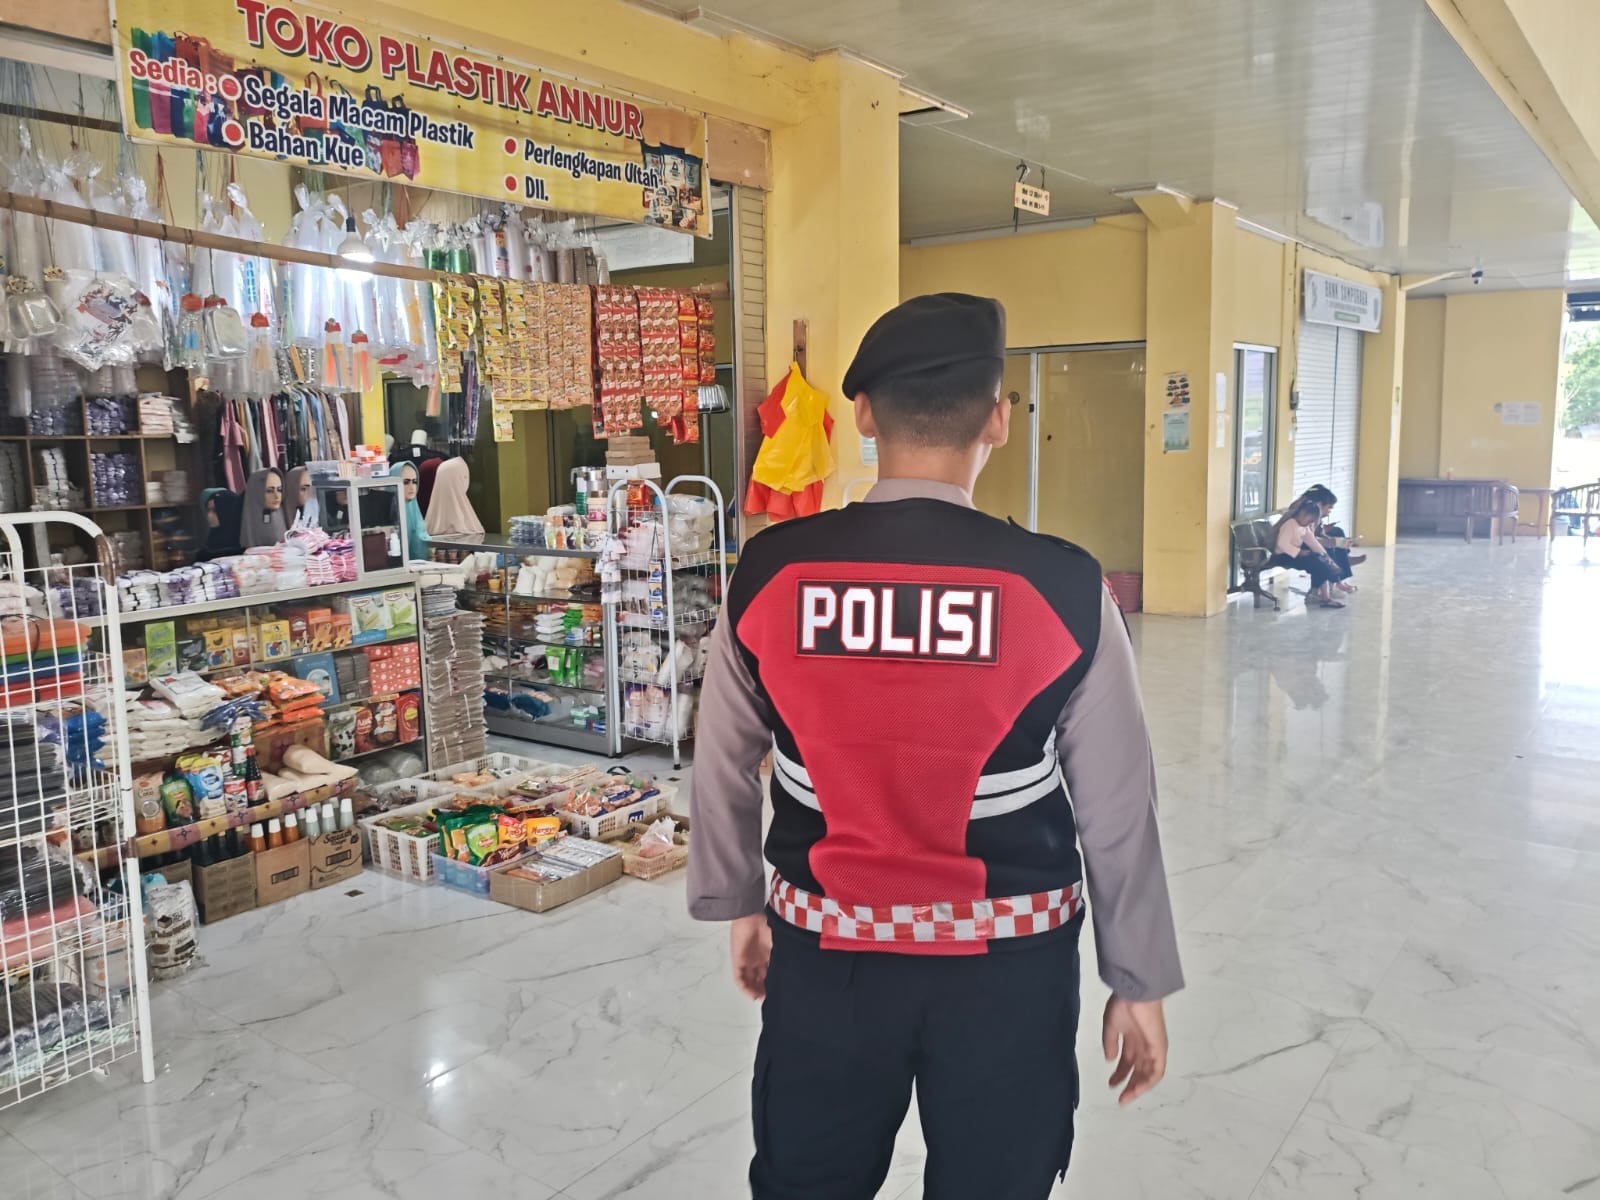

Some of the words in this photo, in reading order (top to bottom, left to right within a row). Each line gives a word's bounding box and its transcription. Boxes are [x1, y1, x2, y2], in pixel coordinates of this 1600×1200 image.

[129, 50, 201, 90] Sedia
[237, 0, 369, 67] TOKO
[380, 36, 529, 109] PLASTIK
[537, 80, 643, 139] ANNUR
[246, 77, 322, 119] Segala
[329, 95, 404, 136] Macam
[410, 113, 474, 149] Plastik
[250, 123, 319, 160] Bahan
[325, 136, 364, 166] Kue
[525, 140, 621, 181] Perlengkapan
[625, 161, 658, 187] Ultah
[1325, 280, 1338, 300] BANK
[802, 586, 993, 657] POLISI
